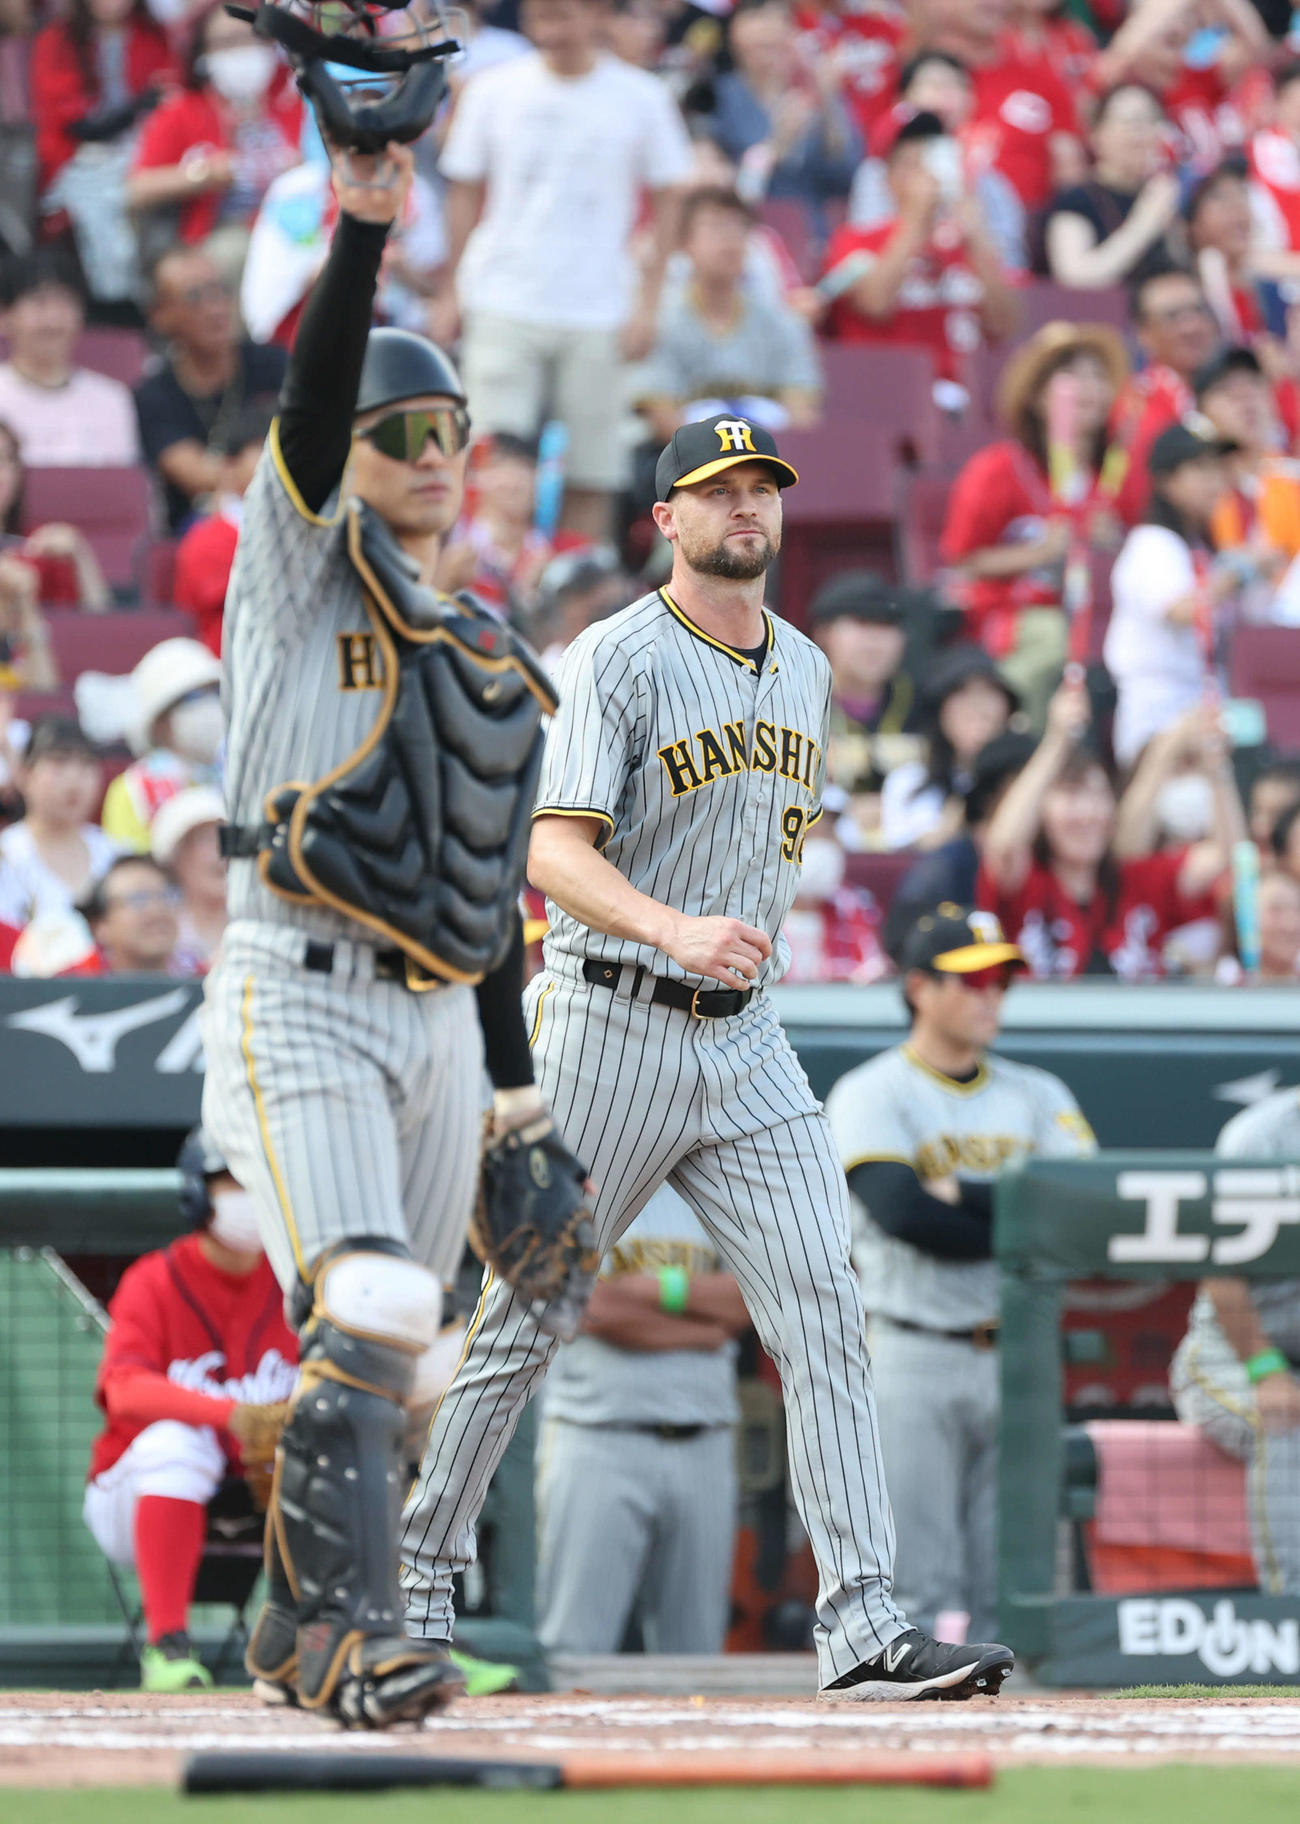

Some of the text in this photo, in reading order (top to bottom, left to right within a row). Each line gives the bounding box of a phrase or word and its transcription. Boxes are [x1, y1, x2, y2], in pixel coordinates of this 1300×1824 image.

[656, 719, 822, 798] HANSHI
[781, 805, 814, 866] 9
[1107, 1166, 1300, 1266] エデ
